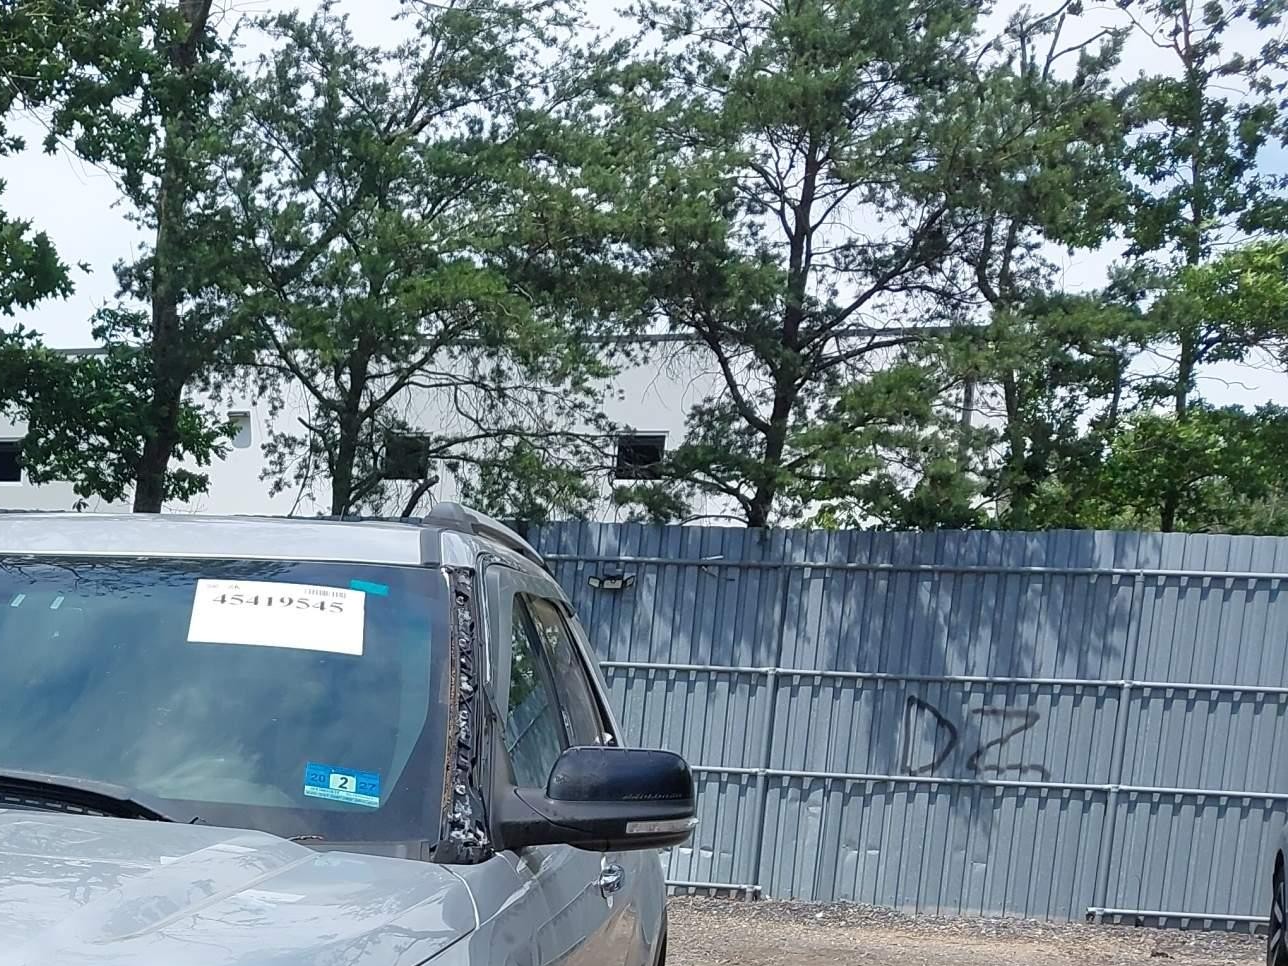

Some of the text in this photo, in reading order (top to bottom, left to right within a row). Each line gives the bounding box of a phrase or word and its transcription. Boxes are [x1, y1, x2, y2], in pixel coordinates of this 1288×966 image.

[212, 592, 345, 614] 45419545
[901, 695, 1051, 782] DZ
[311, 772, 326, 783] 20
[338, 776, 349, 790] 2
